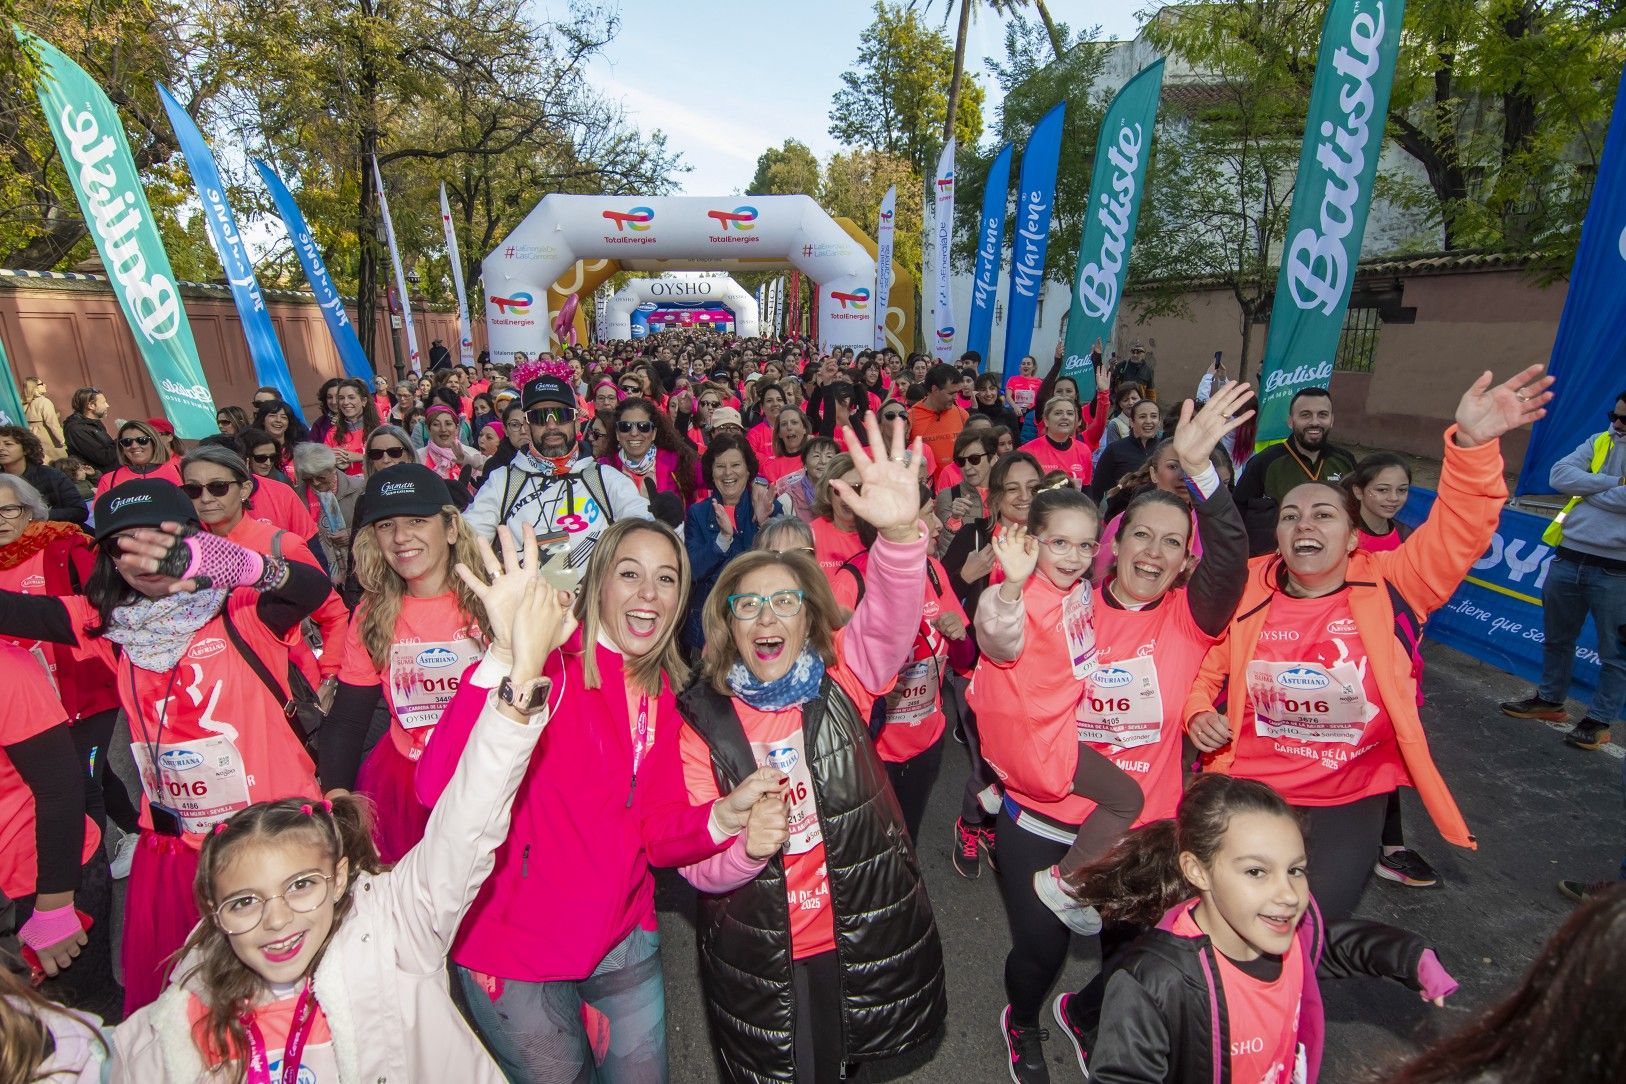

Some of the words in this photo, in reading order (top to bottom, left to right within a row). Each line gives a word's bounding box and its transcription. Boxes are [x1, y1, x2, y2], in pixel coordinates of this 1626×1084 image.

[1287, 1, 1386, 317] Batiste
[1079, 122, 1143, 323] Batiste
[604, 236, 657, 245] TotalEnergies
[709, 236, 760, 244] TotalEnergies
[1015, 190, 1047, 298] Marlene
[975, 217, 999, 310] Marlene
[650, 282, 711, 296] OYSHO
[491, 318, 535, 327] TotalEnergies
[830, 313, 870, 321] TotalEnergies
[1265, 361, 1333, 392] Batiste
[1488, 617, 1523, 635] que
[420, 656, 455, 664] ASTURIANA
[423, 677, 460, 692] 016
[1094, 673, 1131, 684] ASTURIANA
[1280, 676, 1326, 685] ASTURIANA
[903, 685, 927, 699] 016
[1091, 698, 1131, 712] 016
[1284, 700, 1330, 713] 016
[406, 713, 438, 723] OYSHO
[1274, 742, 1320, 760] CARRERA
[1321, 749, 1334, 758] DE
[1336, 748, 1348, 762] LA
[1116, 758, 1151, 773] MUJER
[1321, 757, 1339, 770] 2025
[169, 781, 208, 797] 016
[789, 781, 808, 807] 16
[209, 805, 233, 815] SEVILLA
[799, 888, 814, 902] DE
[815, 882, 829, 895] LA
[801, 897, 821, 910] 2025
[1231, 1036, 1264, 1056] SHO
